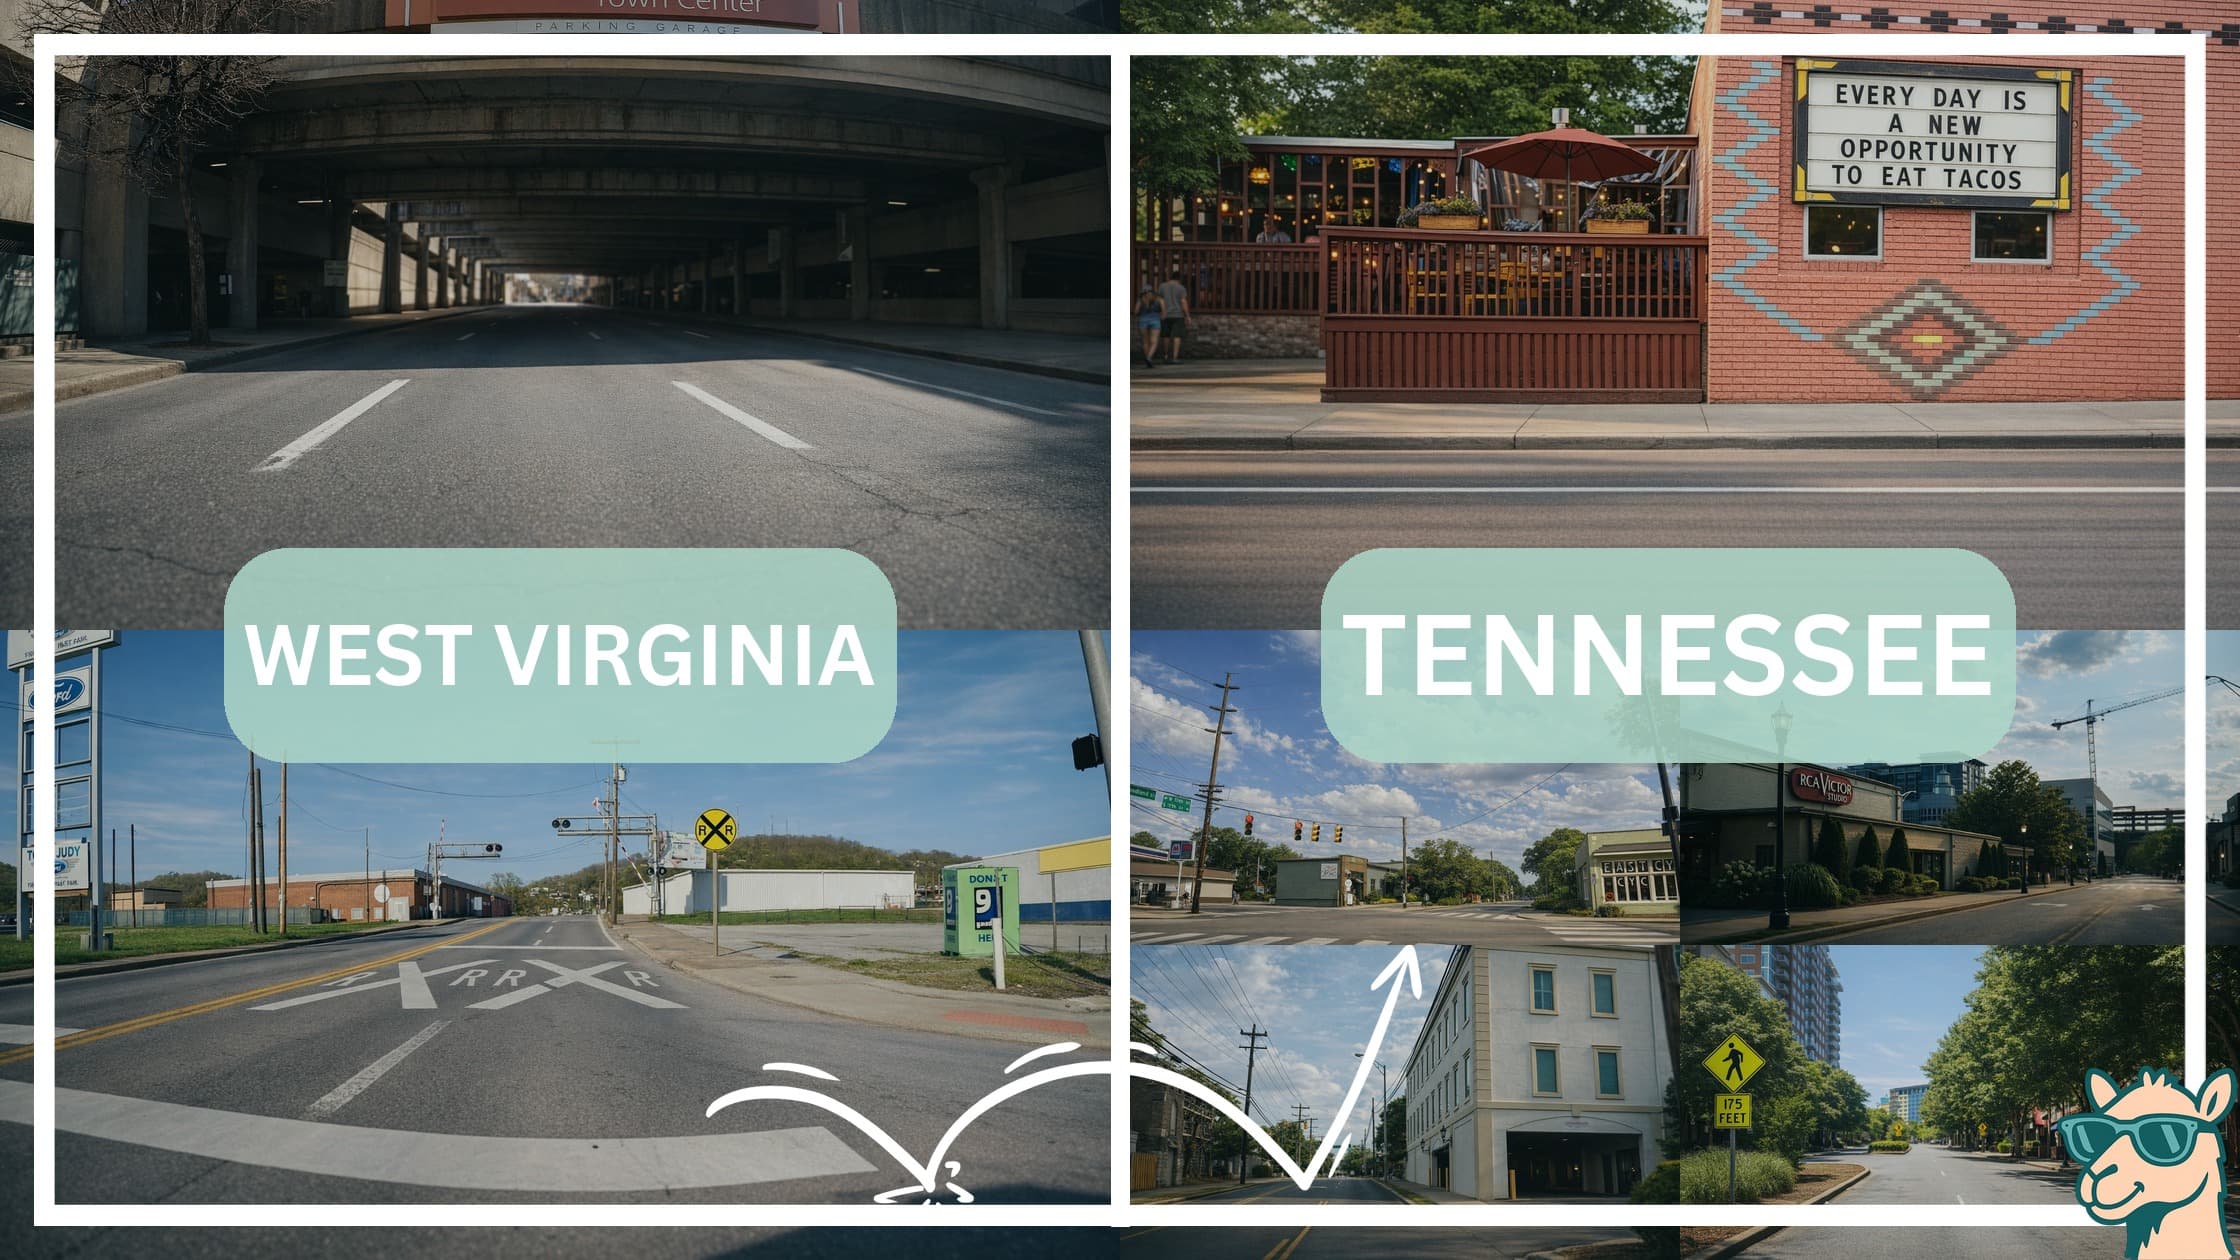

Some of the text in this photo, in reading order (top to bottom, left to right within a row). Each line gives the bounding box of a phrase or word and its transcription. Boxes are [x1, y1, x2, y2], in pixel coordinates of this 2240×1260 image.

[535, 21, 742, 34] PARKING GARAGE
[1836, 84, 2026, 111] EVERY DAY IS
[1888, 113, 1981, 136] A NEW
[1841, 138, 2017, 164] OPPORTUNITY
[1832, 165, 2021, 190] TO EAT TACOS
[1800, 772, 1852, 796] RCA VICTOR
[699, 825, 707, 834] R
[725, 825, 733, 835] R
[56, 846, 80, 858] JUDY
[1604, 862, 1646, 873] EAST
[1617, 877, 1649, 887] CYC
[1724, 1098, 1742, 1110] 175
[1719, 1113, 1746, 1123] FEET
